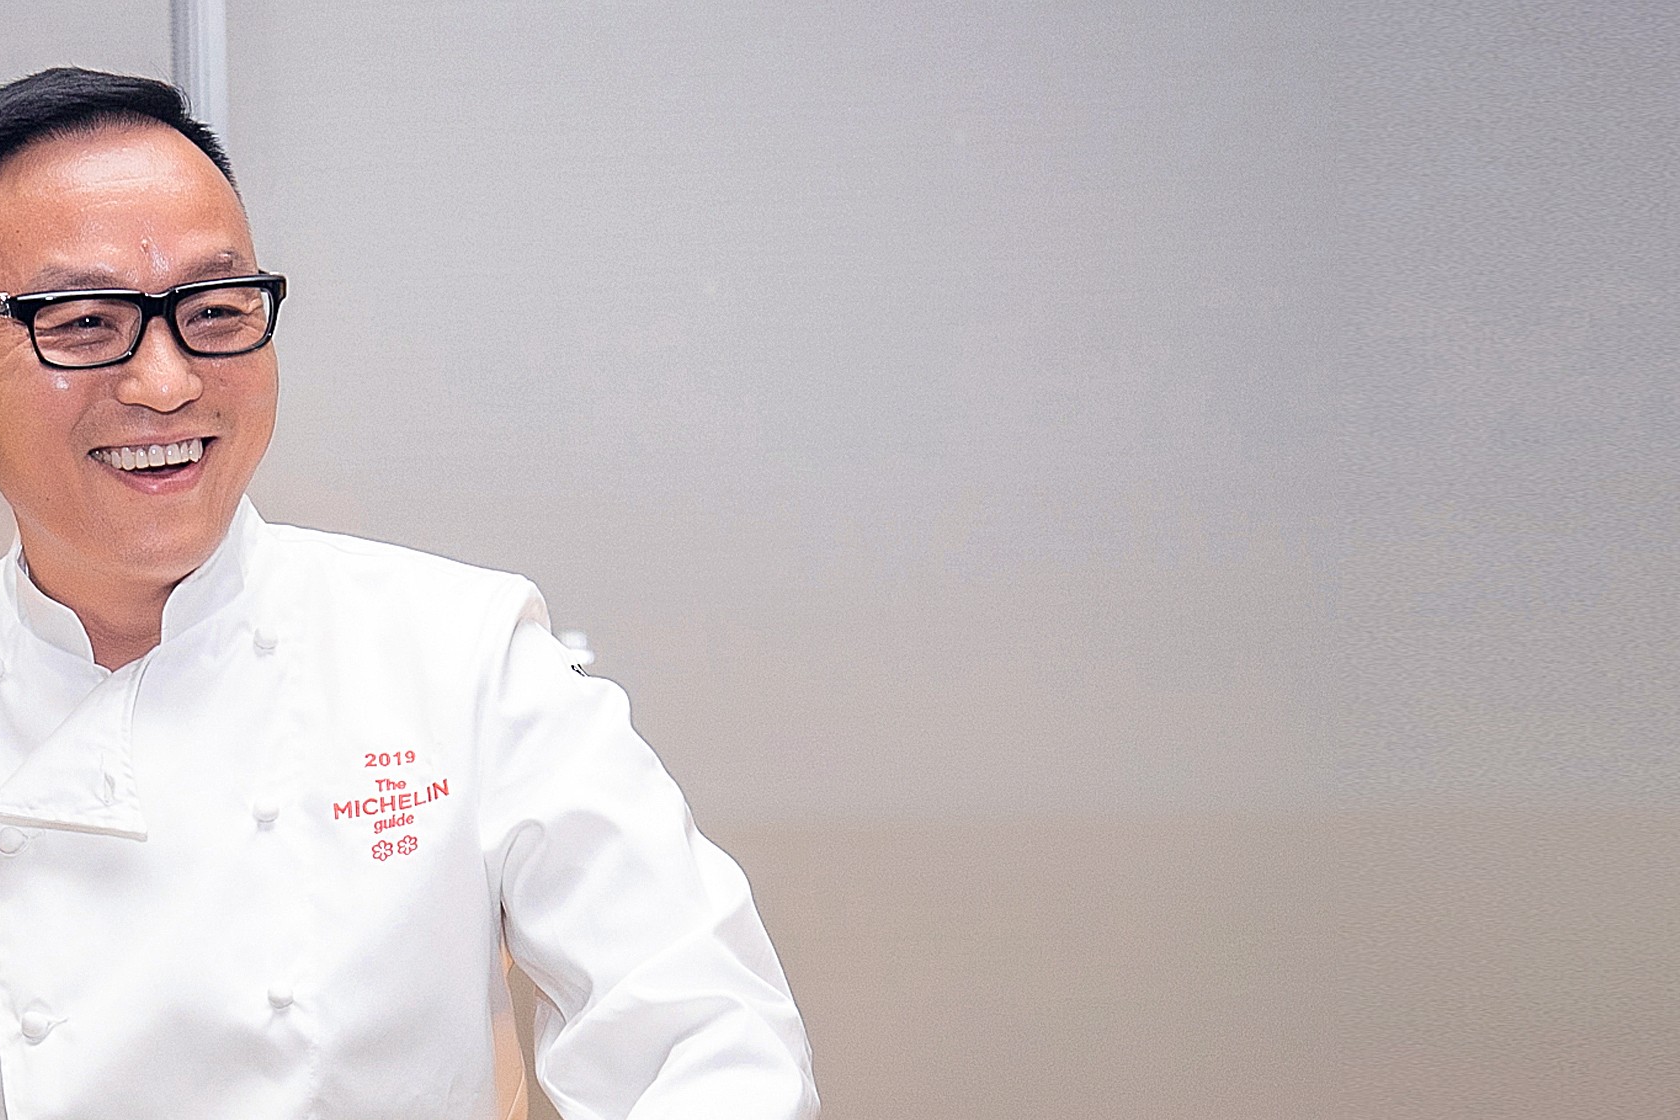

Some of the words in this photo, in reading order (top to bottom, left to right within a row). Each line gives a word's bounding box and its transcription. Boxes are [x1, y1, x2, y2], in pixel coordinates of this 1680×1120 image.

[364, 750, 416, 768] 2019
[375, 778, 407, 792] The
[333, 778, 450, 820] MICHELIN
[373, 812, 415, 834] guide
